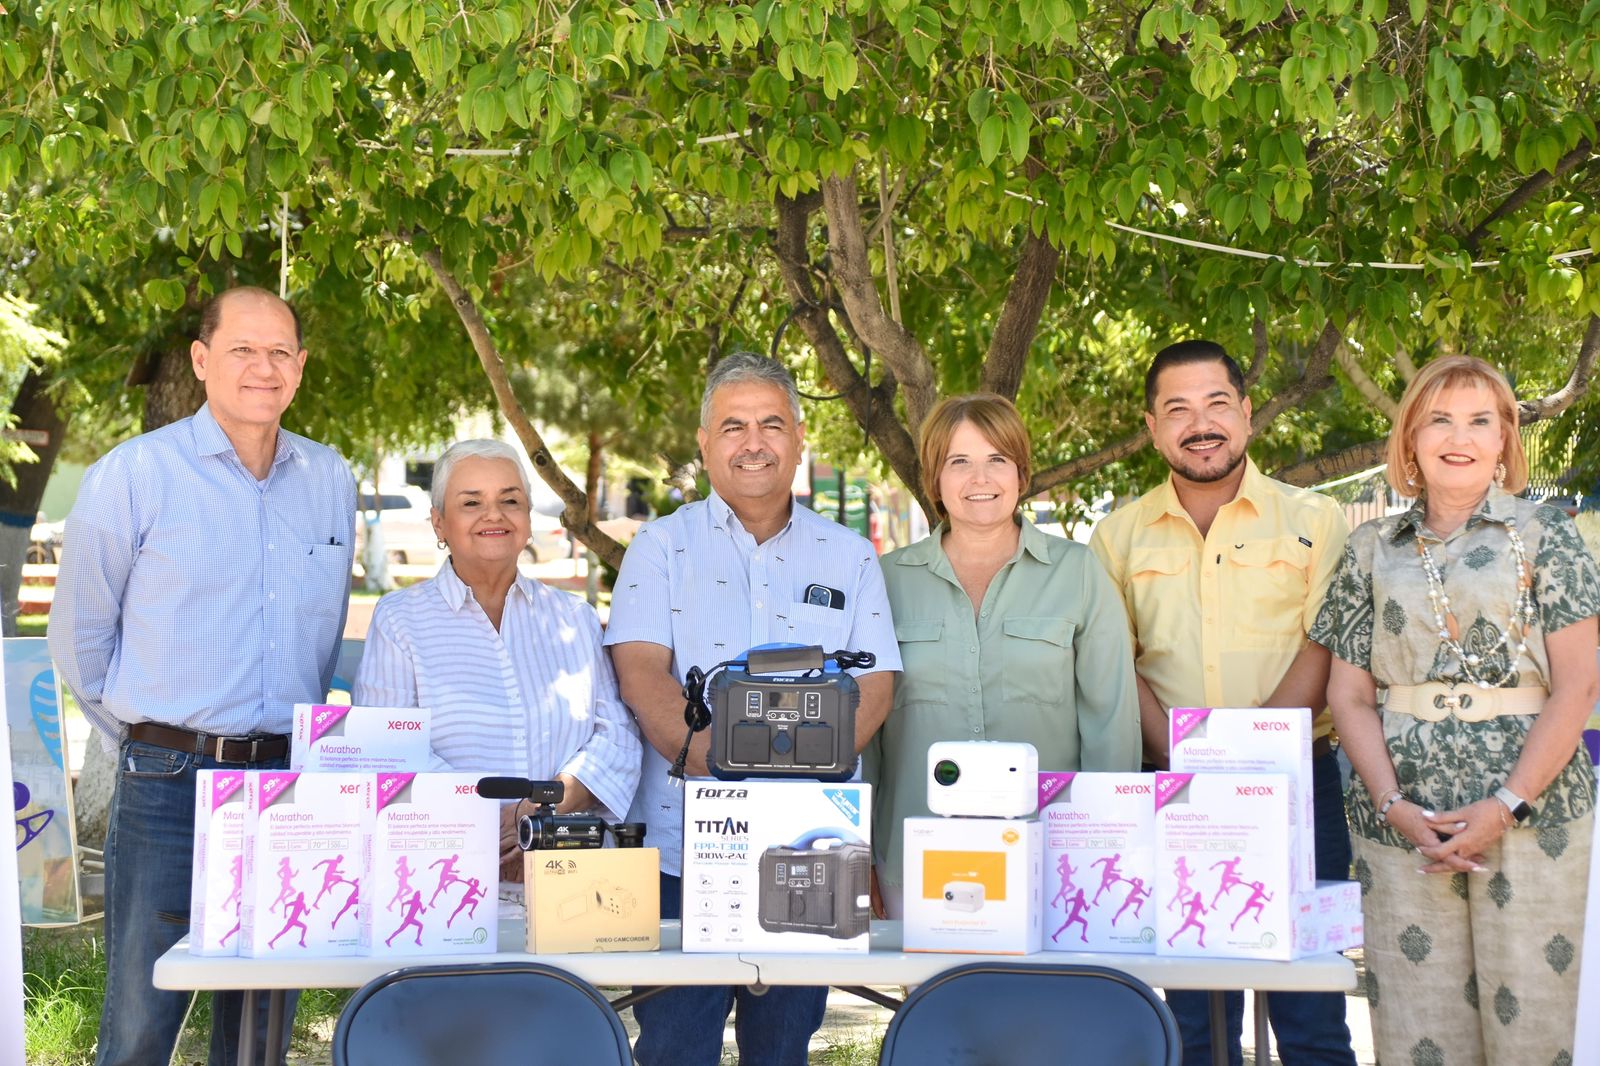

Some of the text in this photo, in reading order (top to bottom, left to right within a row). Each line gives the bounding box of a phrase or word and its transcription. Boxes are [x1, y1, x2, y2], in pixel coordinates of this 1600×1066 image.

[387, 720, 421, 730] xerox
[1253, 721, 1290, 731] xerox
[320, 744, 361, 754] Marathon
[1184, 747, 1226, 756] Marathon
[696, 788, 748, 799] forza
[1115, 784, 1151, 794] xerox
[1236, 786, 1274, 796] xerox
[270, 812, 313, 821] Marathon
[388, 812, 430, 821] Marathon
[1048, 811, 1089, 820] Marathon
[1165, 813, 1209, 821] Marathon
[695, 817, 748, 835] TITAN
[546, 860, 563, 869] 4K
